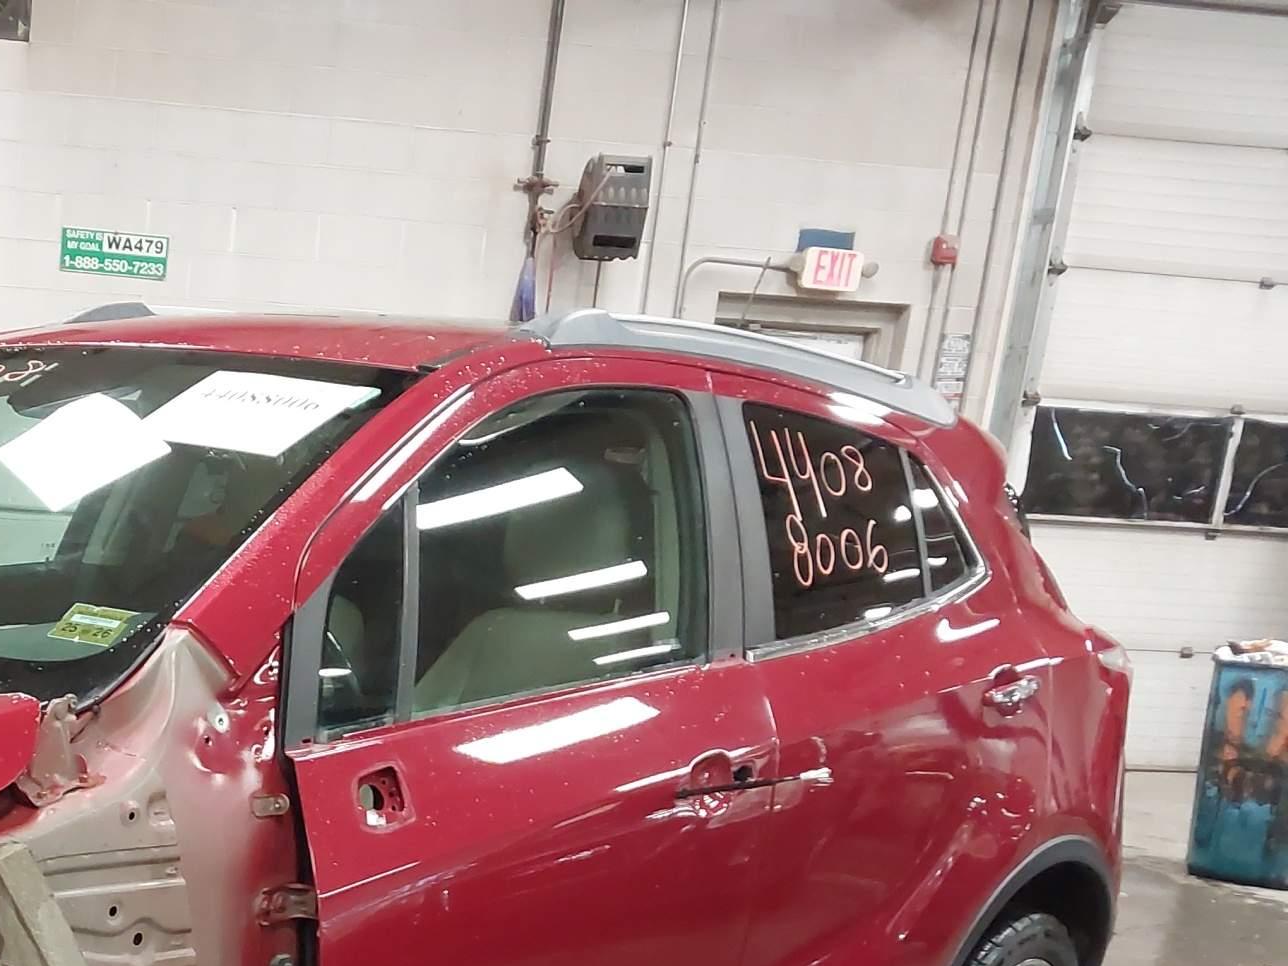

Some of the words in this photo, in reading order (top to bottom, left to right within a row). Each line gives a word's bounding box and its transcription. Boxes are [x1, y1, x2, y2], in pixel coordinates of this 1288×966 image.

[66, 229, 94, 240] SAFETY
[107, 235, 164, 255] WA479
[63, 254, 164, 276] 1-888-550-7233
[813, 249, 858, 288] EXIT
[750, 420, 872, 522] 4408
[785, 513, 889, 590] 8006
